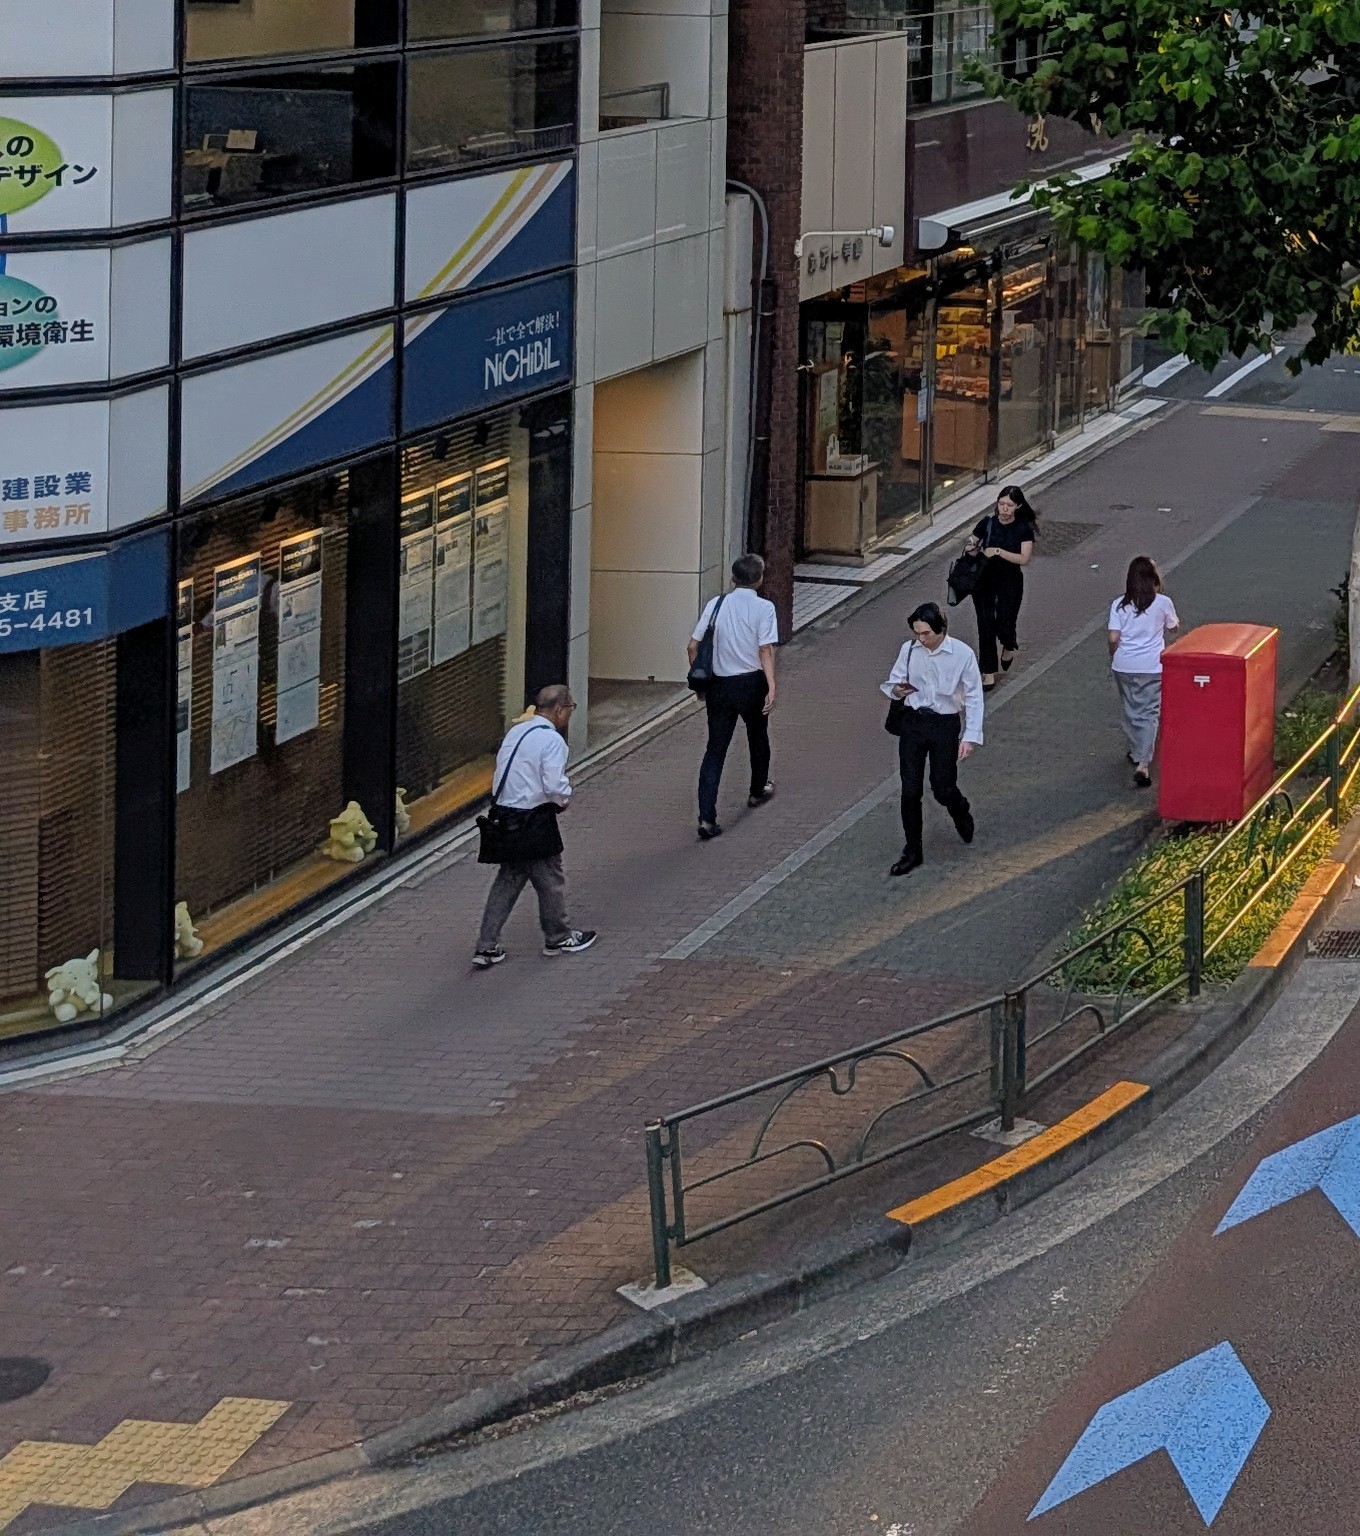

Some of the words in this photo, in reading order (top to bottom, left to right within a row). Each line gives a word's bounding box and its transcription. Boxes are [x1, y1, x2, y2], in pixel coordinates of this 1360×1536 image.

[0, 135, 34, 158] の
[0, 164, 97, 187] デザイン
[2, 472, 92, 501] 建設業
[3, 503, 91, 533] 事務所
[0, 589, 48, 612] 支店
